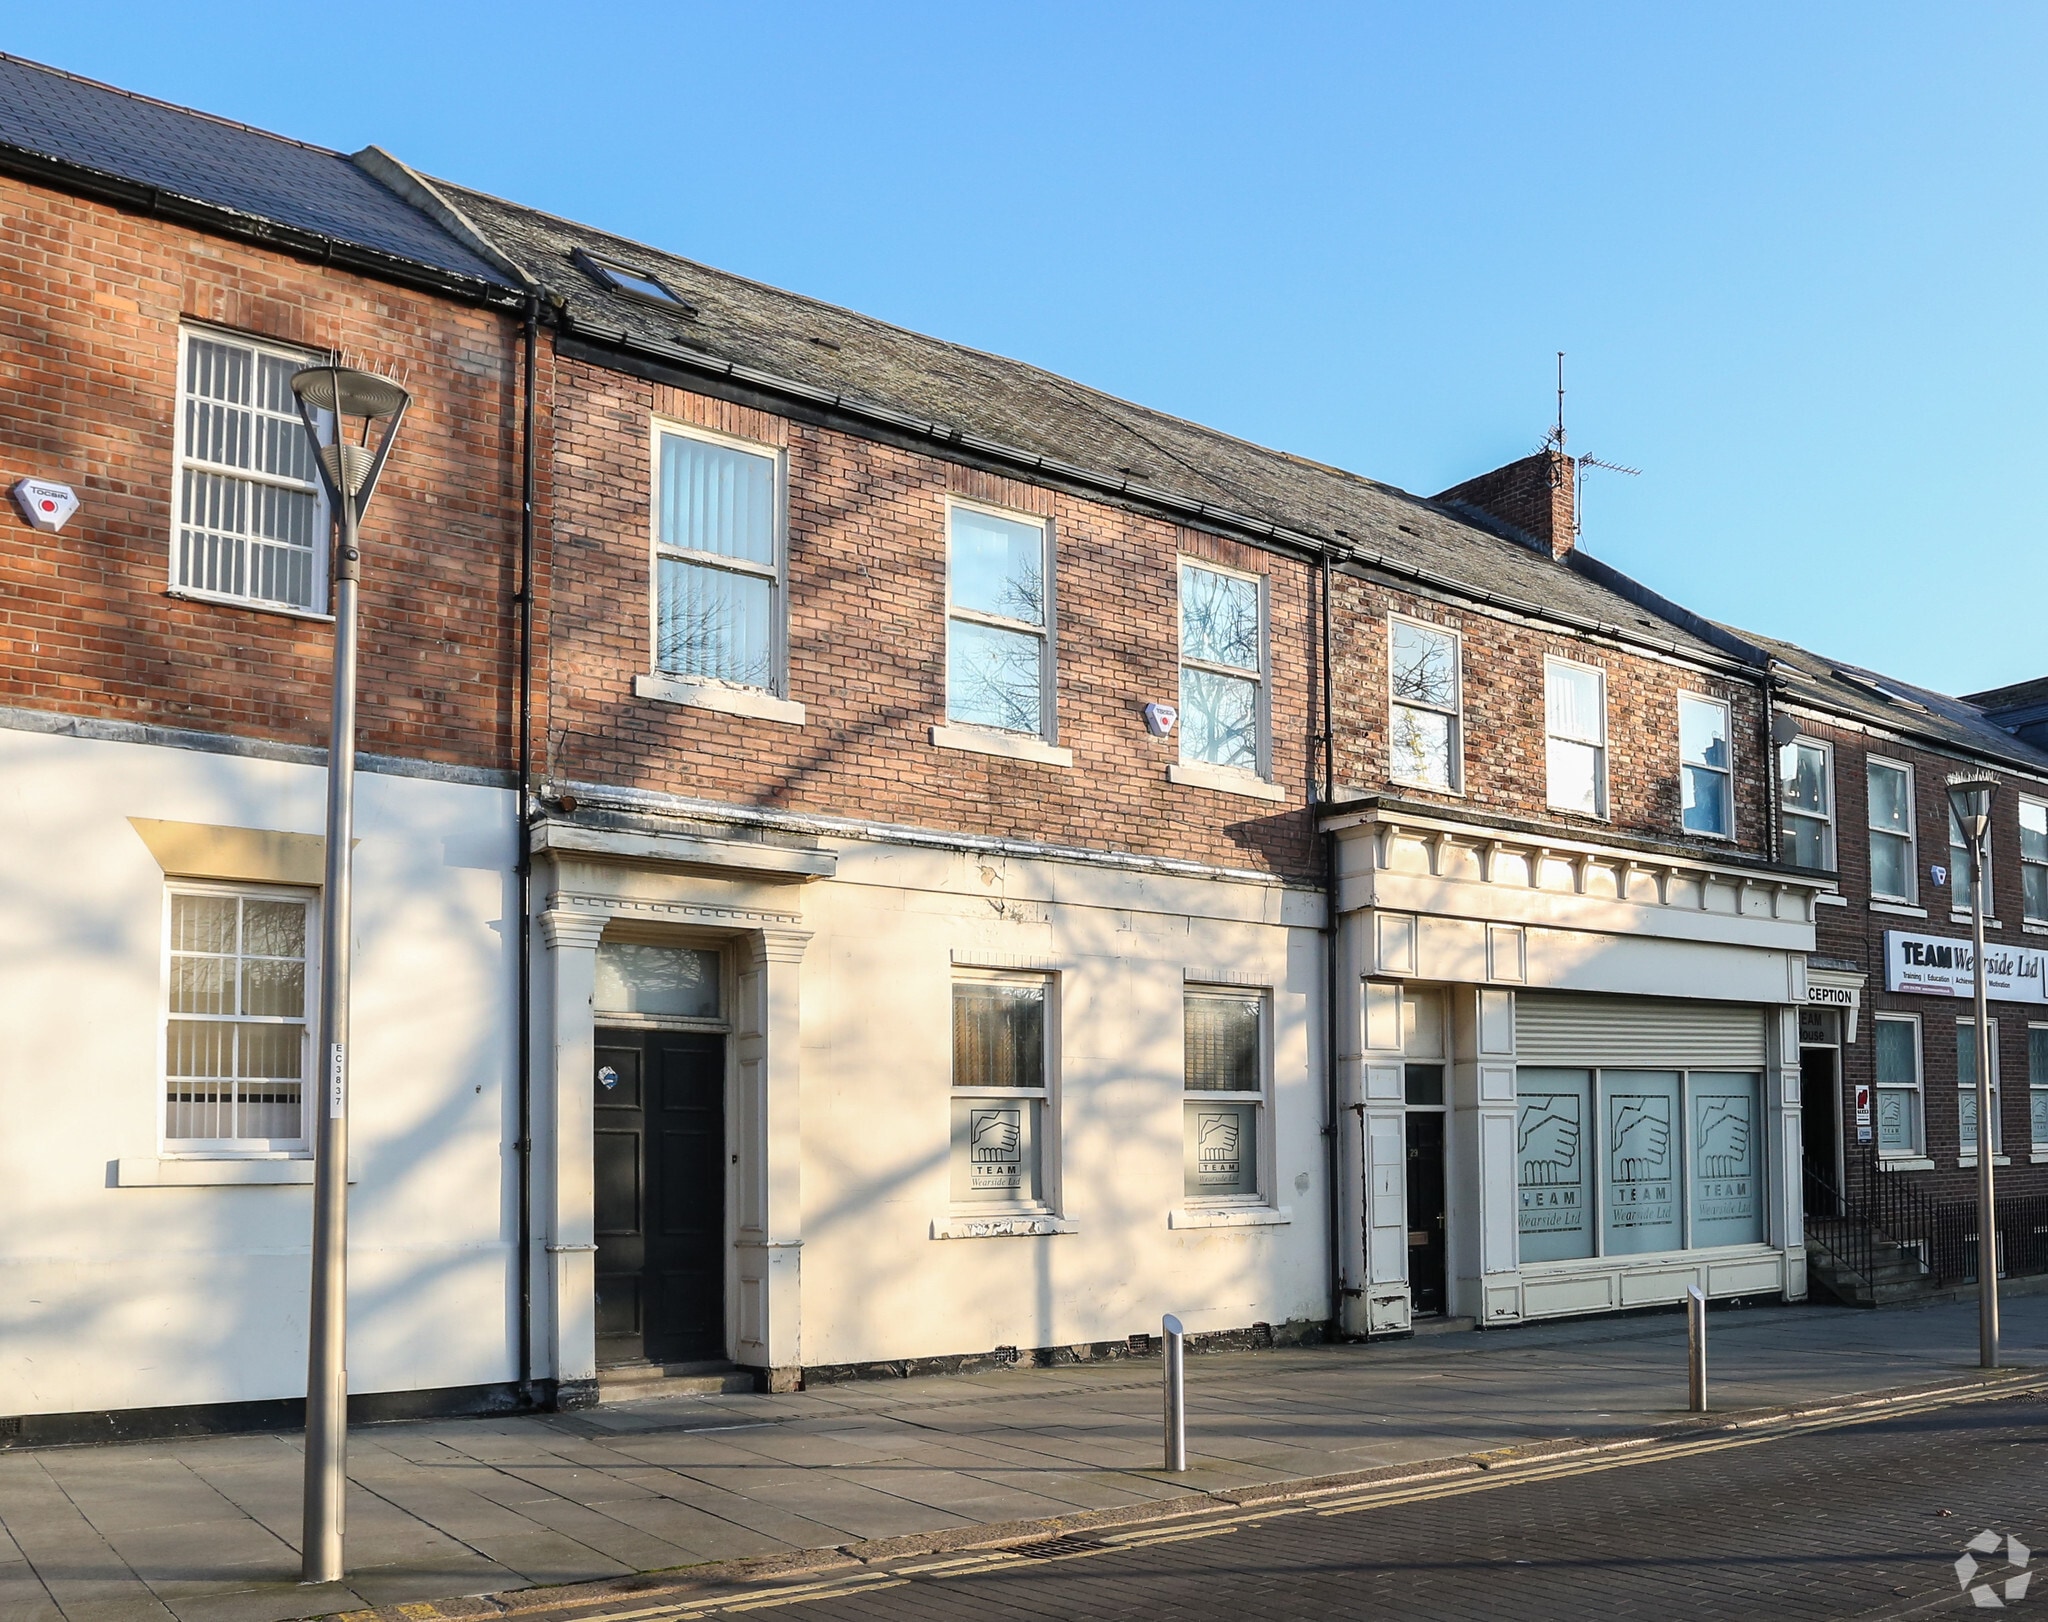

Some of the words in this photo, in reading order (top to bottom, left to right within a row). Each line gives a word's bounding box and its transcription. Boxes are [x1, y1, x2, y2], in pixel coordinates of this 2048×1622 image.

[30, 486, 68, 500] TOCSIN
[1902, 941, 1952, 969] TEAM
[1954, 947, 2014, 976] Werside
[2017, 955, 2039, 978] Ltd
[1903, 971, 1922, 982] Training
[1928, 974, 1950, 983] Education
[1955, 977, 1975, 985] Achieve
[1808, 987, 1852, 1003] CEPTION
[1801, 1011, 1822, 1026] EAM
[335, 1044, 343, 1105] EC3837
[977, 1166, 1016, 1175] TEAM
[972, 1178, 1006, 1187] Wearside
[1008, 1177, 1020, 1186] Ltd
[1619, 1187, 1666, 1201] TEAM
[1704, 1183, 1746, 1197] TEAM
[1523, 1192, 1574, 1206] TEAM
[1564, 1211, 1581, 1225] Ltd
[1657, 1206, 1671, 1219] Ltd
